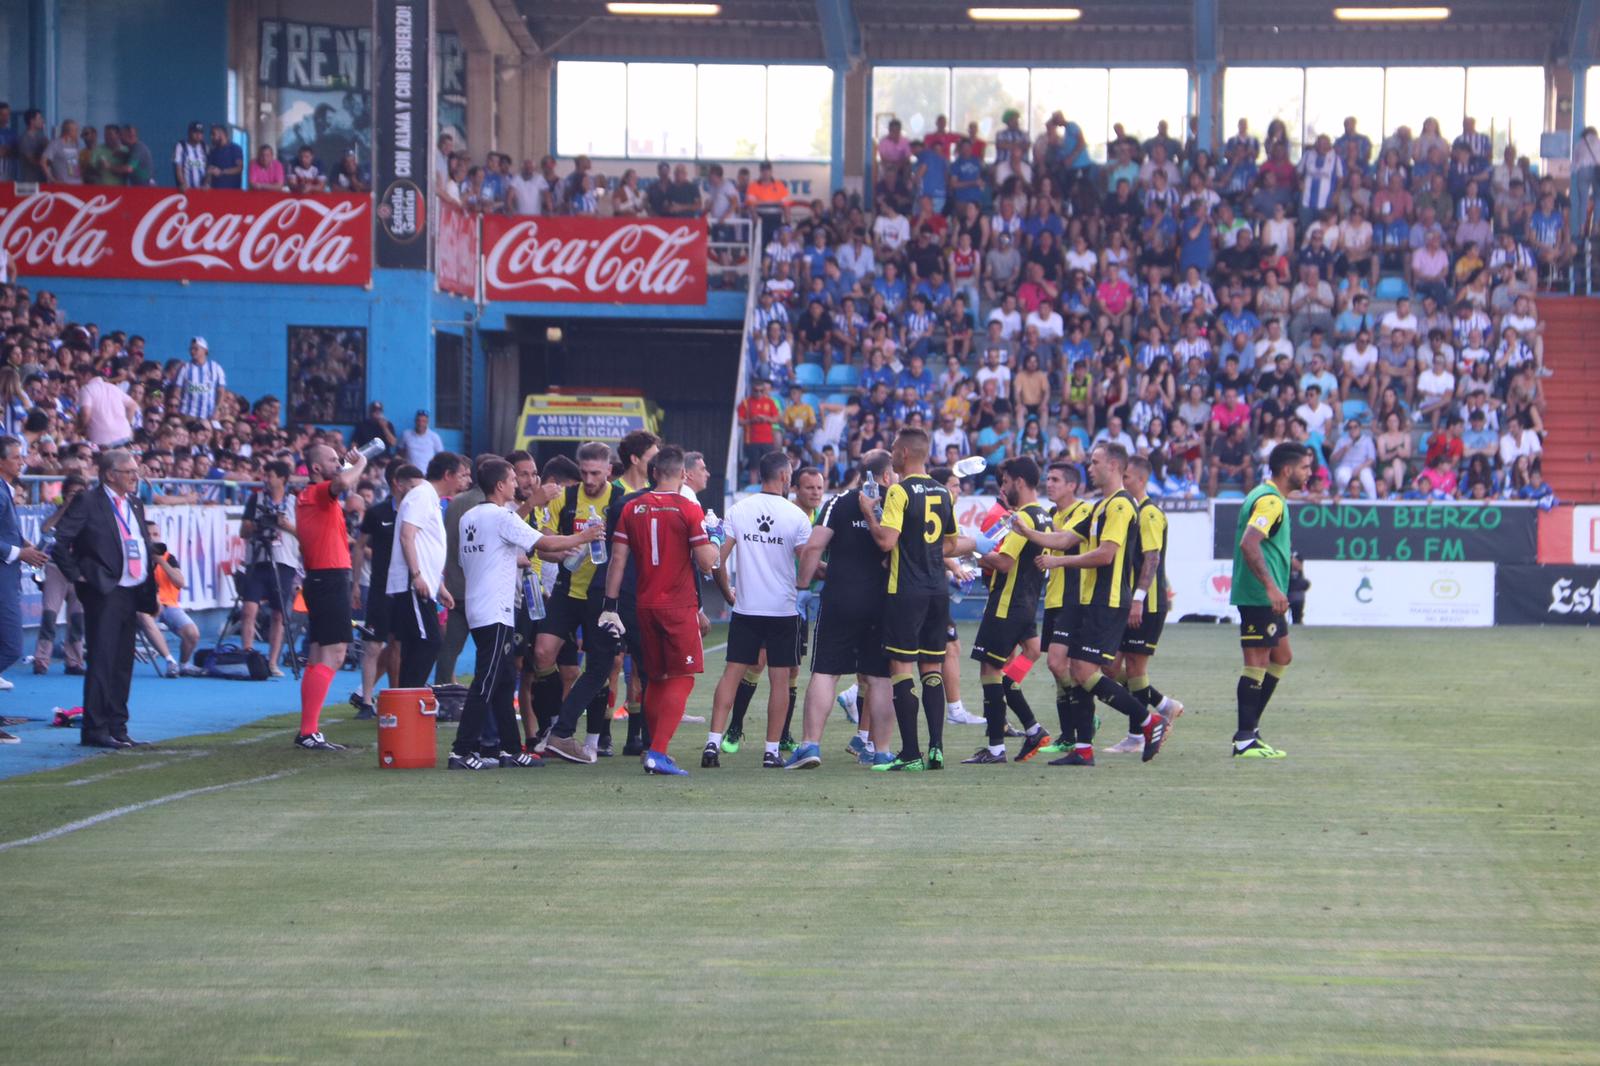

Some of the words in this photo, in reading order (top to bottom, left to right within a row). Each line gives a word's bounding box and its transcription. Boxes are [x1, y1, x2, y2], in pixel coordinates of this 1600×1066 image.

[395, 5, 412, 70] ESFUERZO!
[394, 71, 411, 98] CON
[394, 100, 411, 110] Y
[394, 111, 411, 149] ALMA
[394, 151, 411, 177] CON
[131, 193, 367, 274] Coca-Cola
[486, 221, 700, 294] Coca-Cola
[537, 415, 630, 427] AMBULANCIA
[537, 426, 628, 437] ASISTENCIAL
[923, 495, 943, 544] 5
[1299, 506, 1381, 529] ONDA
[1393, 505, 1502, 530] BIERZO
[651, 518, 660, 566] 1
[743, 533, 785, 546] KELME
[1335, 537, 1412, 561] 101.6
[1424, 538, 1466, 561] FM
